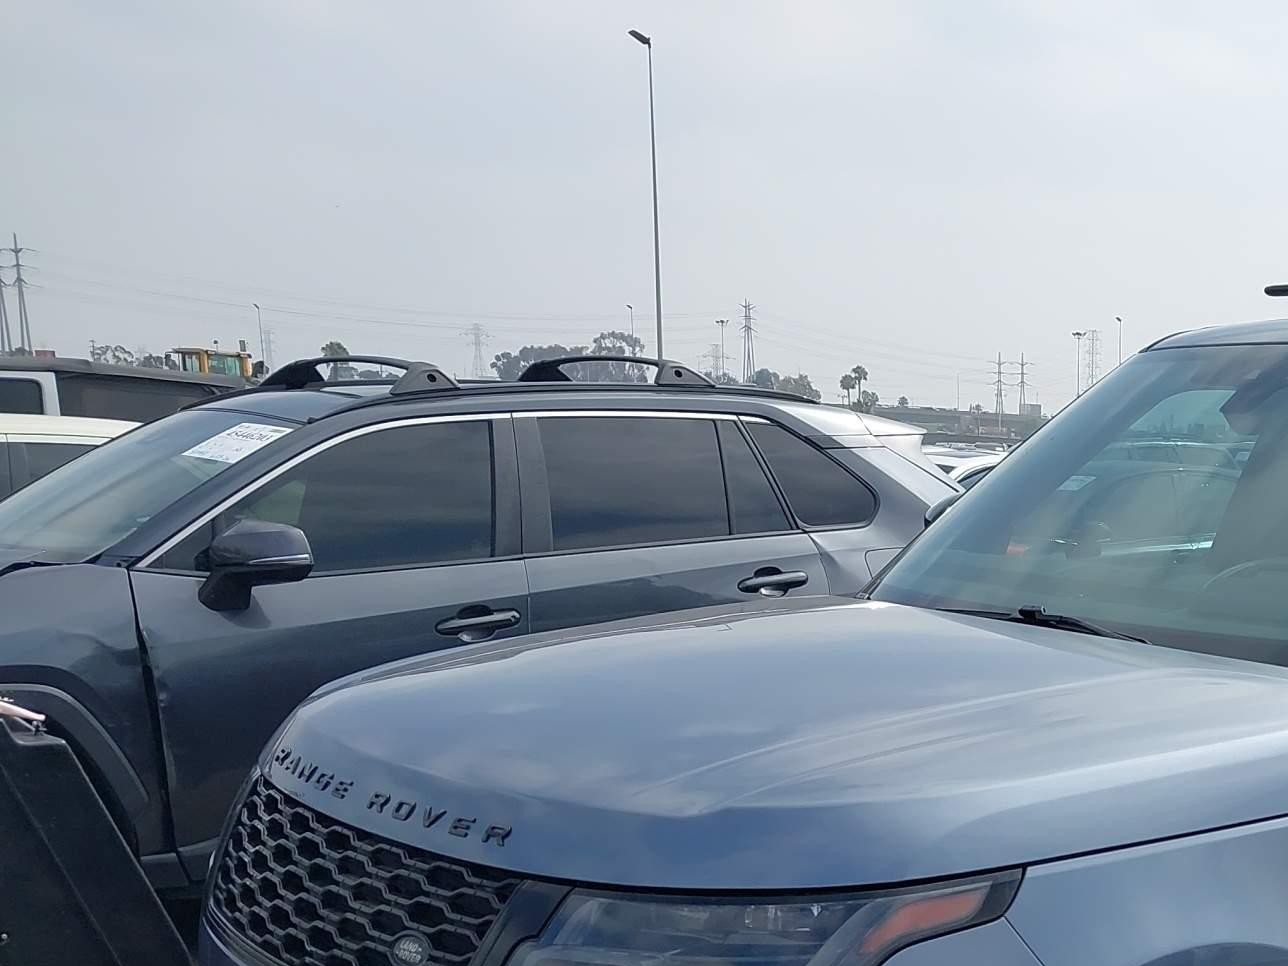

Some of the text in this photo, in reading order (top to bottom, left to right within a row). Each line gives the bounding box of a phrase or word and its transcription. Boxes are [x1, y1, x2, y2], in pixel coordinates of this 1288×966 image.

[274, 748, 513, 848] RANGE ROVER
[400, 940, 418, 952] LAND
